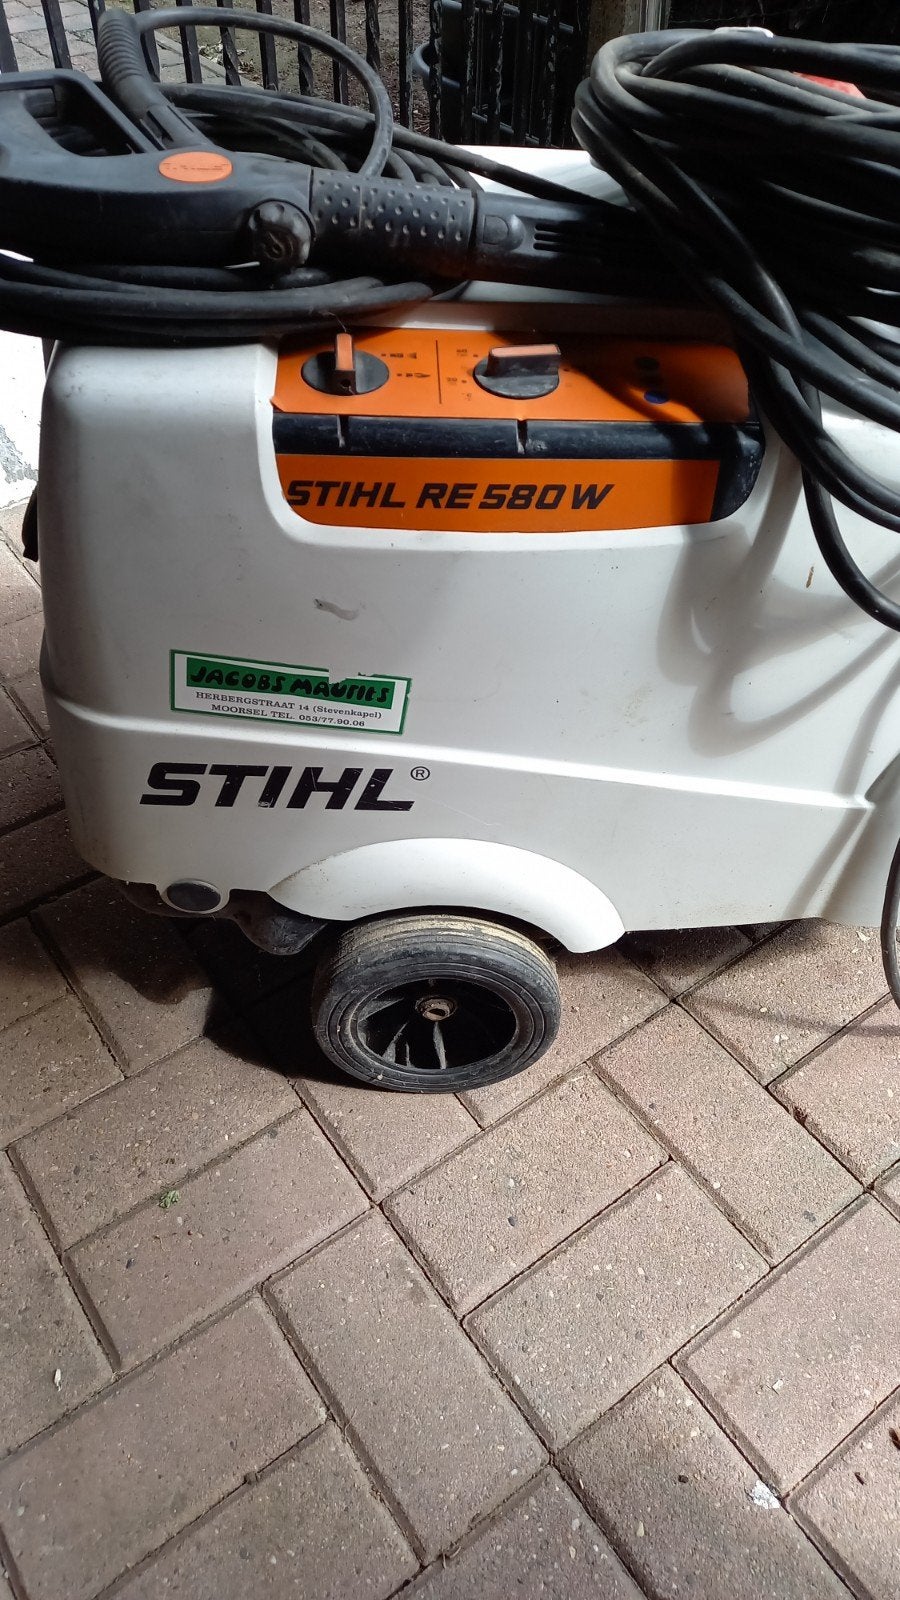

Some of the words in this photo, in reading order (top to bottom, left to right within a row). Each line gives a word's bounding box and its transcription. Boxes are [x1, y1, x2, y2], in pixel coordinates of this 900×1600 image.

[286, 480, 406, 508] STIHL
[415, 482, 478, 509] RE
[477, 483, 568, 510] 580
[571, 483, 615, 510] W
[190, 666, 286, 693] JACOBS
[195, 691, 296, 710] HERBERGSTRAAT
[299, 704, 310, 712] 14
[312, 705, 382, 720] (Stevenkapel)
[211, 704, 268, 717] MOORSEL
[270, 710, 296, 720] TEL.
[139, 761, 415, 811] STIHL
